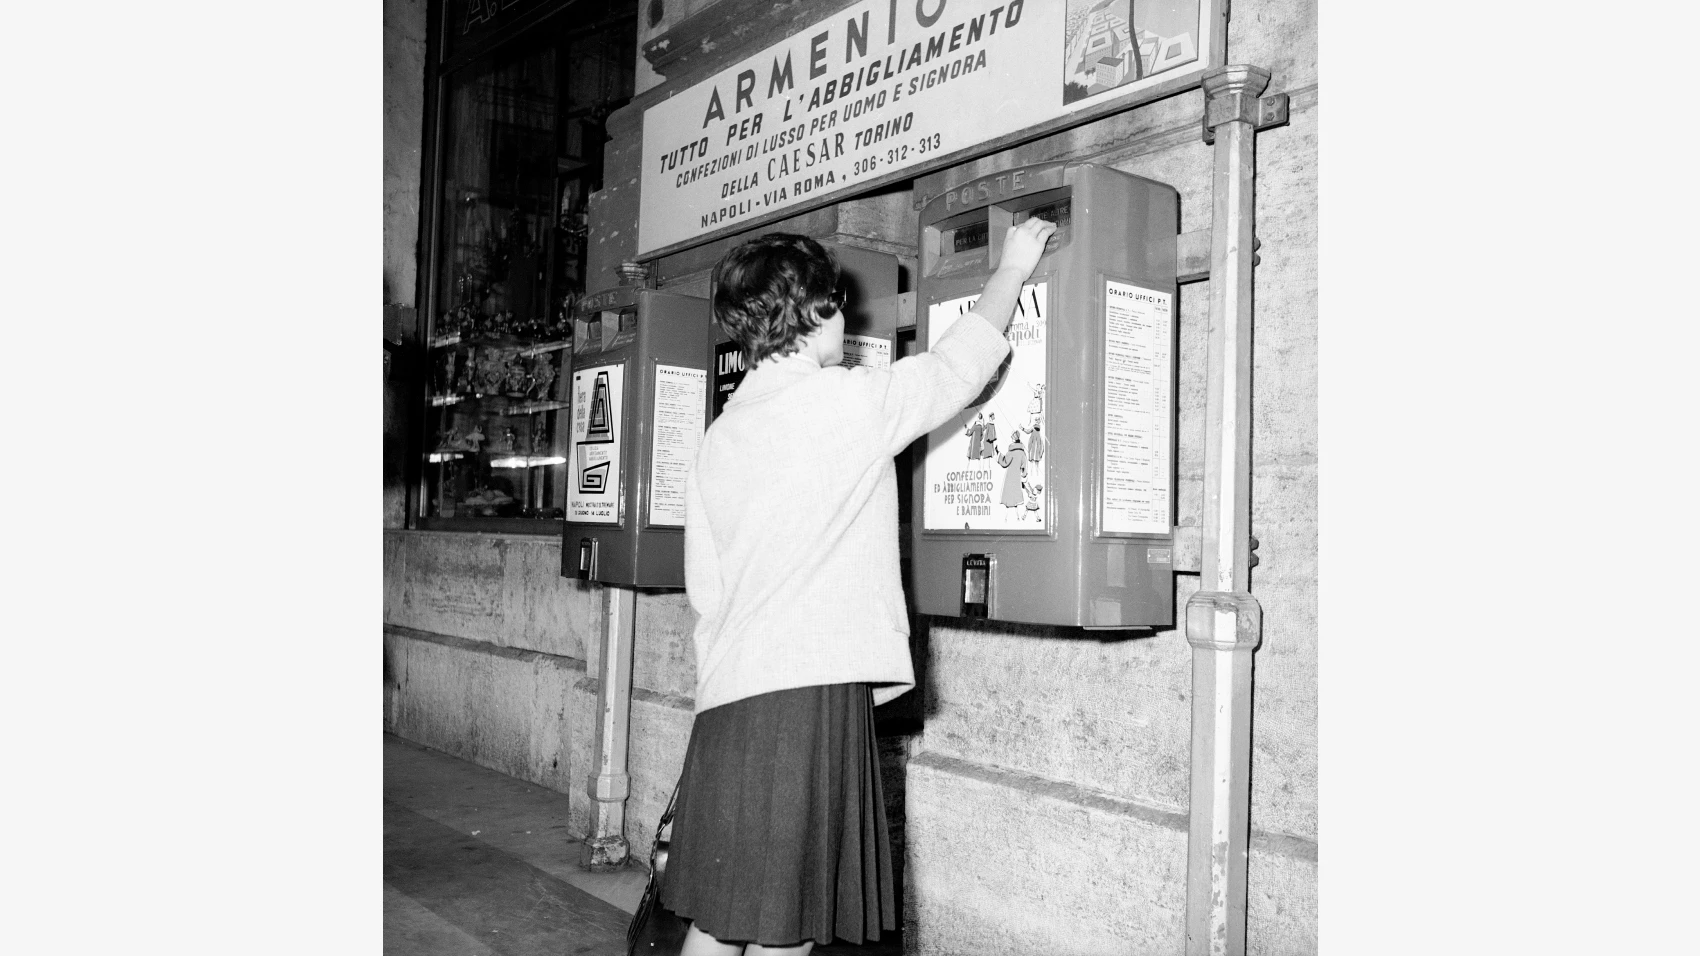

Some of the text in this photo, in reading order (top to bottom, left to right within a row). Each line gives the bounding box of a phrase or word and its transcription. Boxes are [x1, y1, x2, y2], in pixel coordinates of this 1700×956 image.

[702, 0, 947, 129] ARMENIO
[660, 0, 1025, 174] TUTTO PER L'ABBIGLIAMENTO
[676, 49, 987, 188] CONFEZIONI DI LUSSO PER UOMO E SIGNORA
[721, 111, 914, 199] DELLA CAESAR TORINO
[946, 170, 1025, 211] POSTE
[1109, 288, 1133, 299] ORARIO
[1135, 294, 1155, 303] UFFICI
[859, 341, 877, 349] UFFICI
[1004, 325, 1040, 347] apoli
[719, 350, 746, 376] LIMO
[946, 470, 992, 481] CONFEZIONI
[934, 484, 941, 493] ED
[944, 493, 992, 504] PER SIGNORA
[956, 507, 960, 516] E
